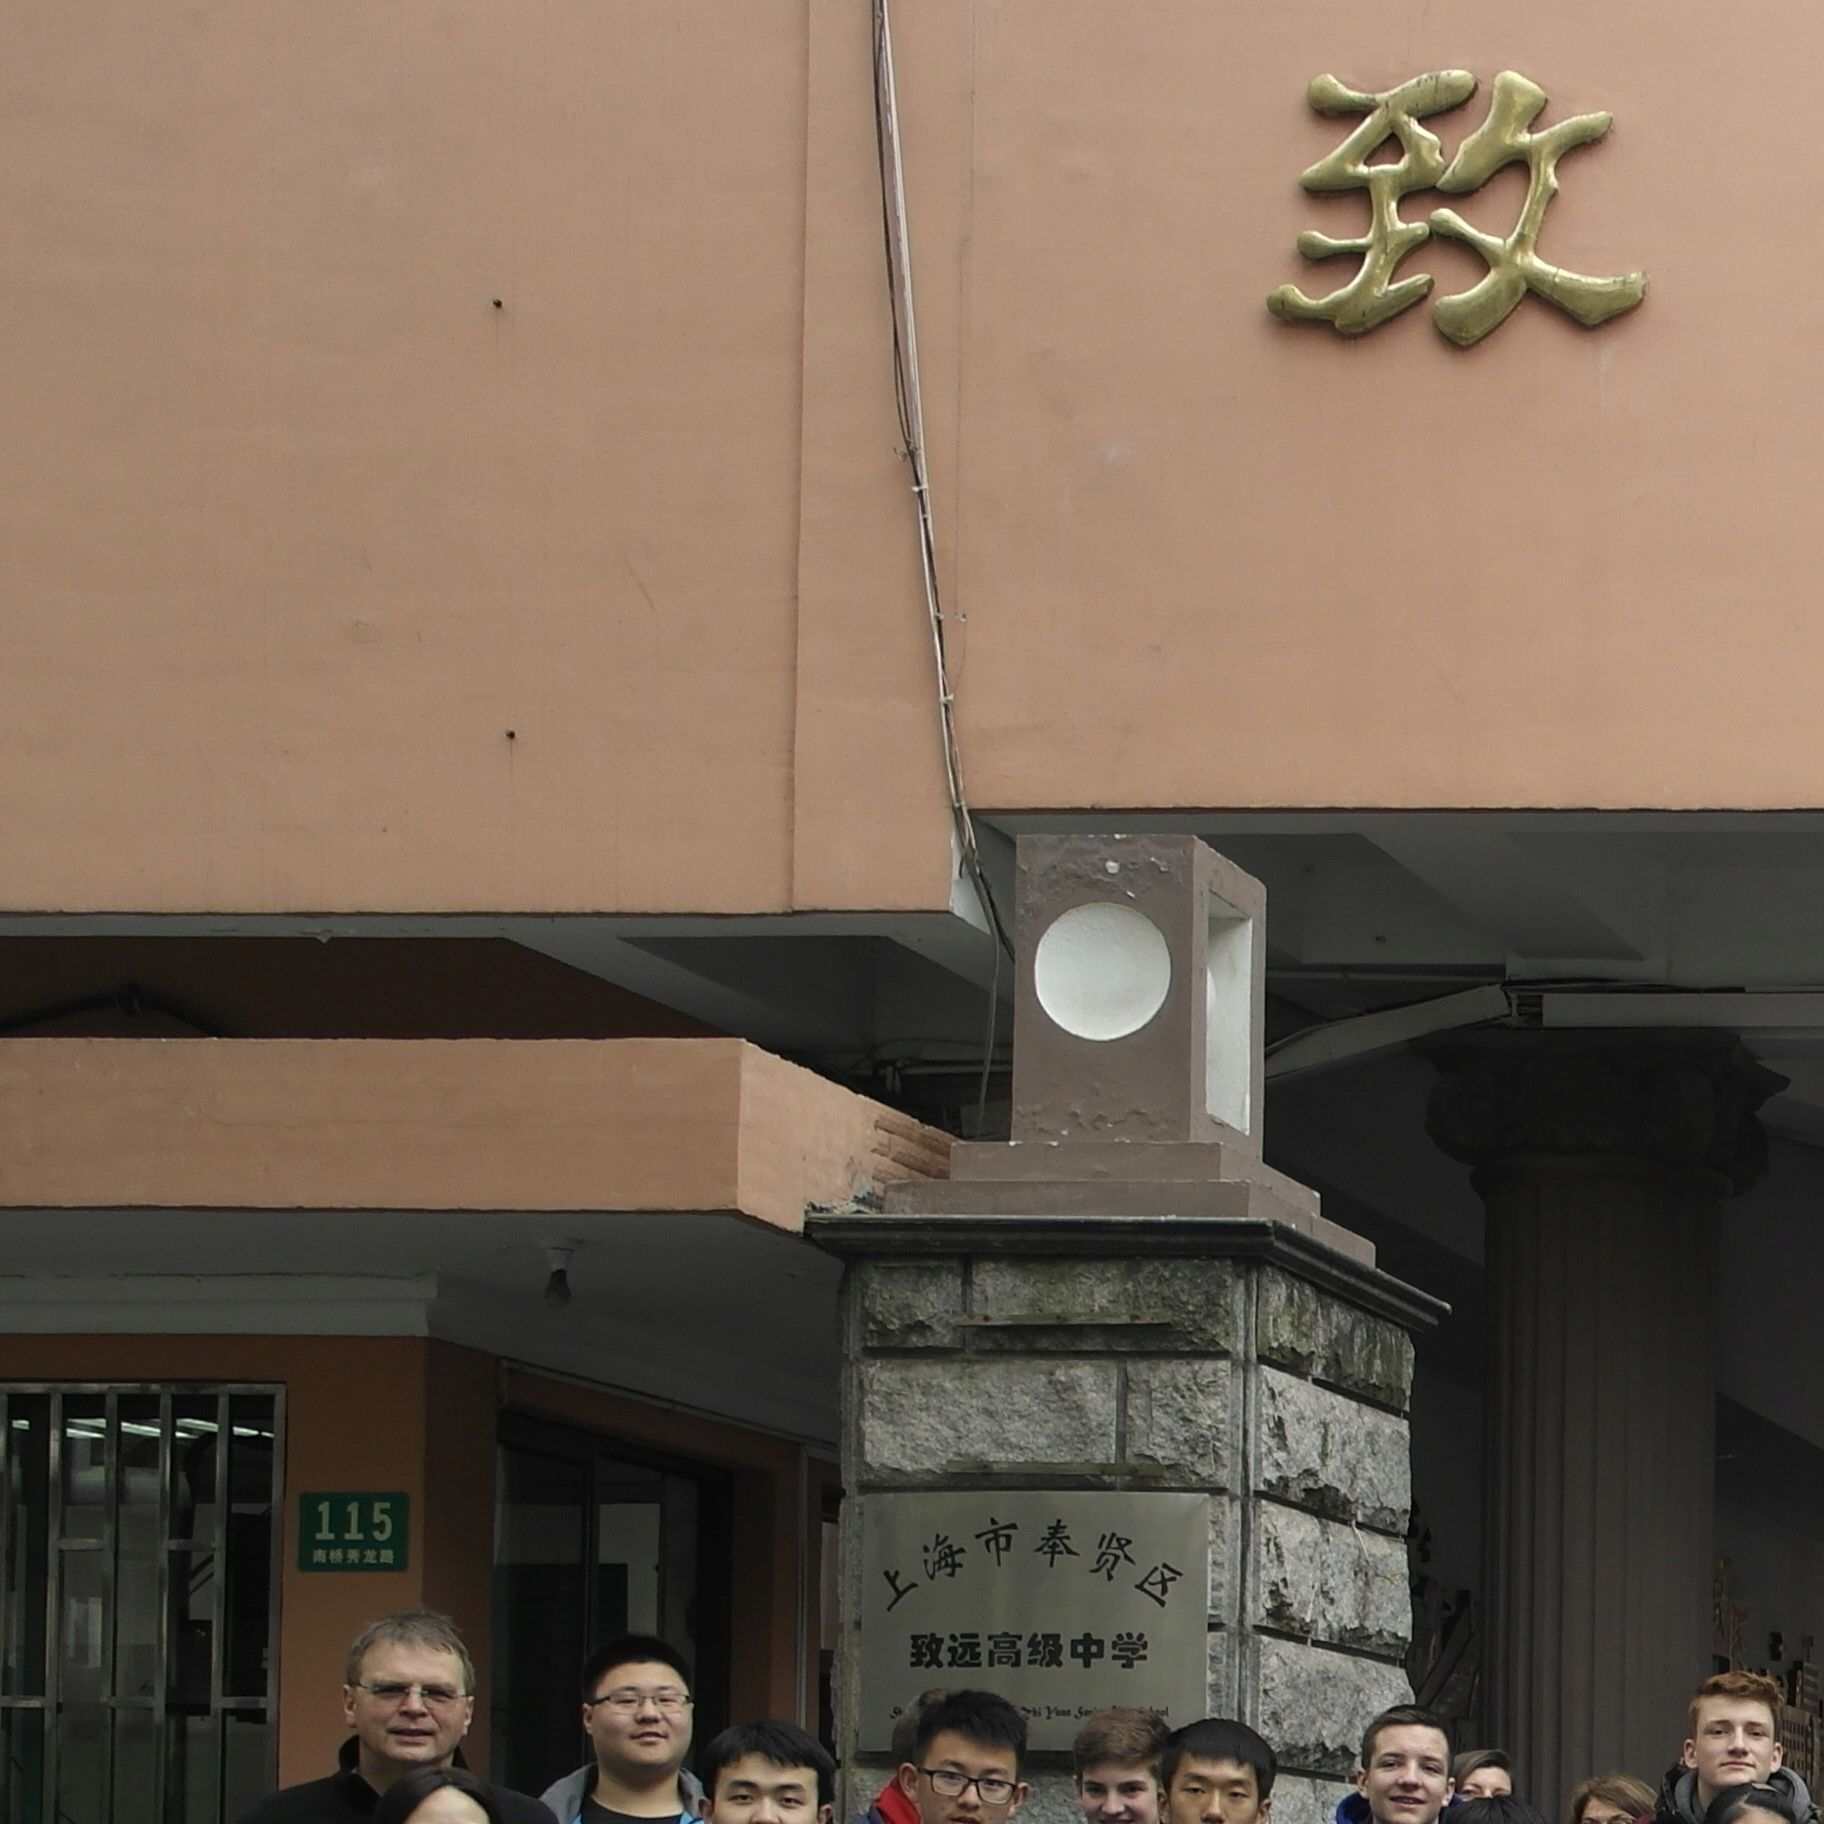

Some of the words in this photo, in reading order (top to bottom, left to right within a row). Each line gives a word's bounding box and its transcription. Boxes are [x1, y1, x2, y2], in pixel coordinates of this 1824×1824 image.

[314, 1501, 393, 1541] 115
[312, 1548, 395, 1565] 南桥秀龙路
[878, 1516, 1184, 1613] 上海市奉贤区
[908, 1631, 1149, 1669] 致远高级中学
